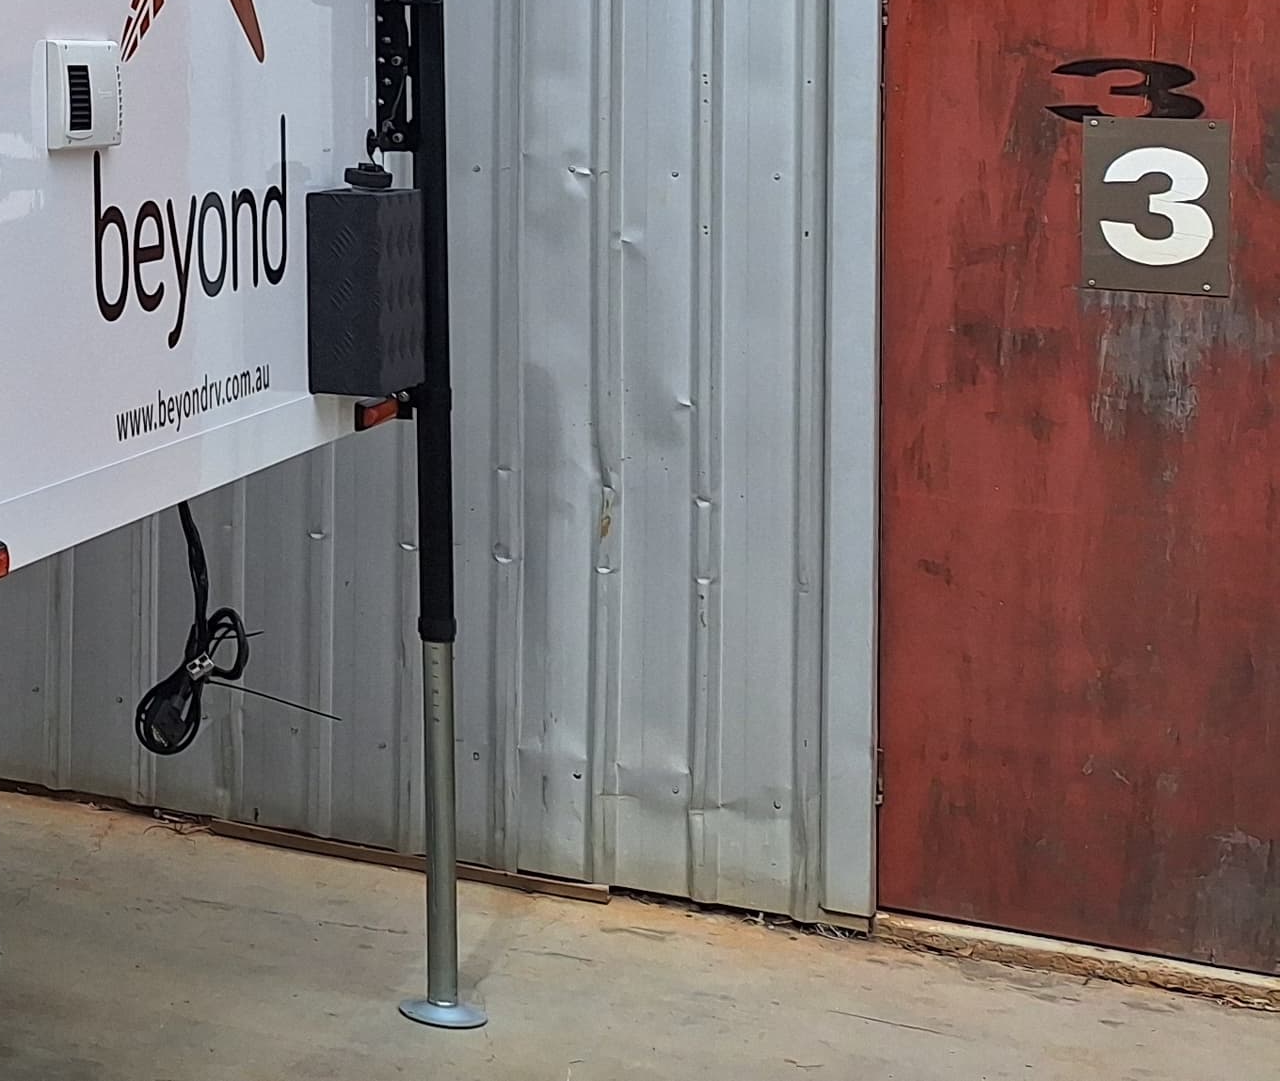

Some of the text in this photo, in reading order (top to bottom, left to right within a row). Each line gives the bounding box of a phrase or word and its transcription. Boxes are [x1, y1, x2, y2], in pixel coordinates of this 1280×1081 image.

[1045, 58, 1205, 123] 3
[93, 114, 287, 349] beyond
[1100, 146, 1214, 266] 3
[116, 363, 270, 441] www.beyondrv.com.au
